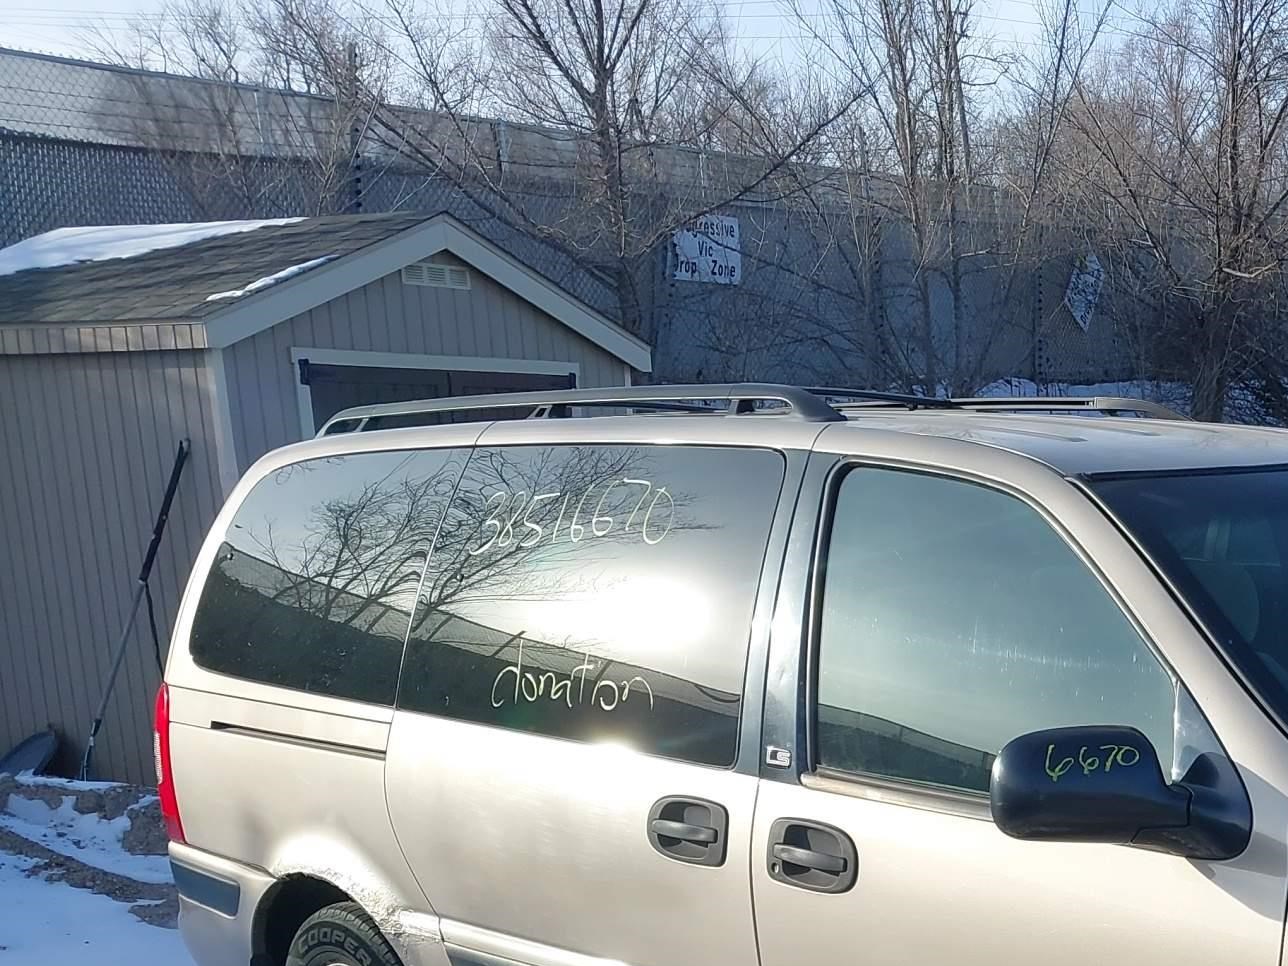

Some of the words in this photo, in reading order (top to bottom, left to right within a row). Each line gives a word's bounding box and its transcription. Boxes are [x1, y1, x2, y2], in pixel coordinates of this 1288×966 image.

[697, 240, 713, 257] Vic
[711, 259, 736, 278] Zone
[470, 478, 674, 555] 38516670
[491, 639, 653, 711] donation
[1044, 744, 1139, 782] 6670
